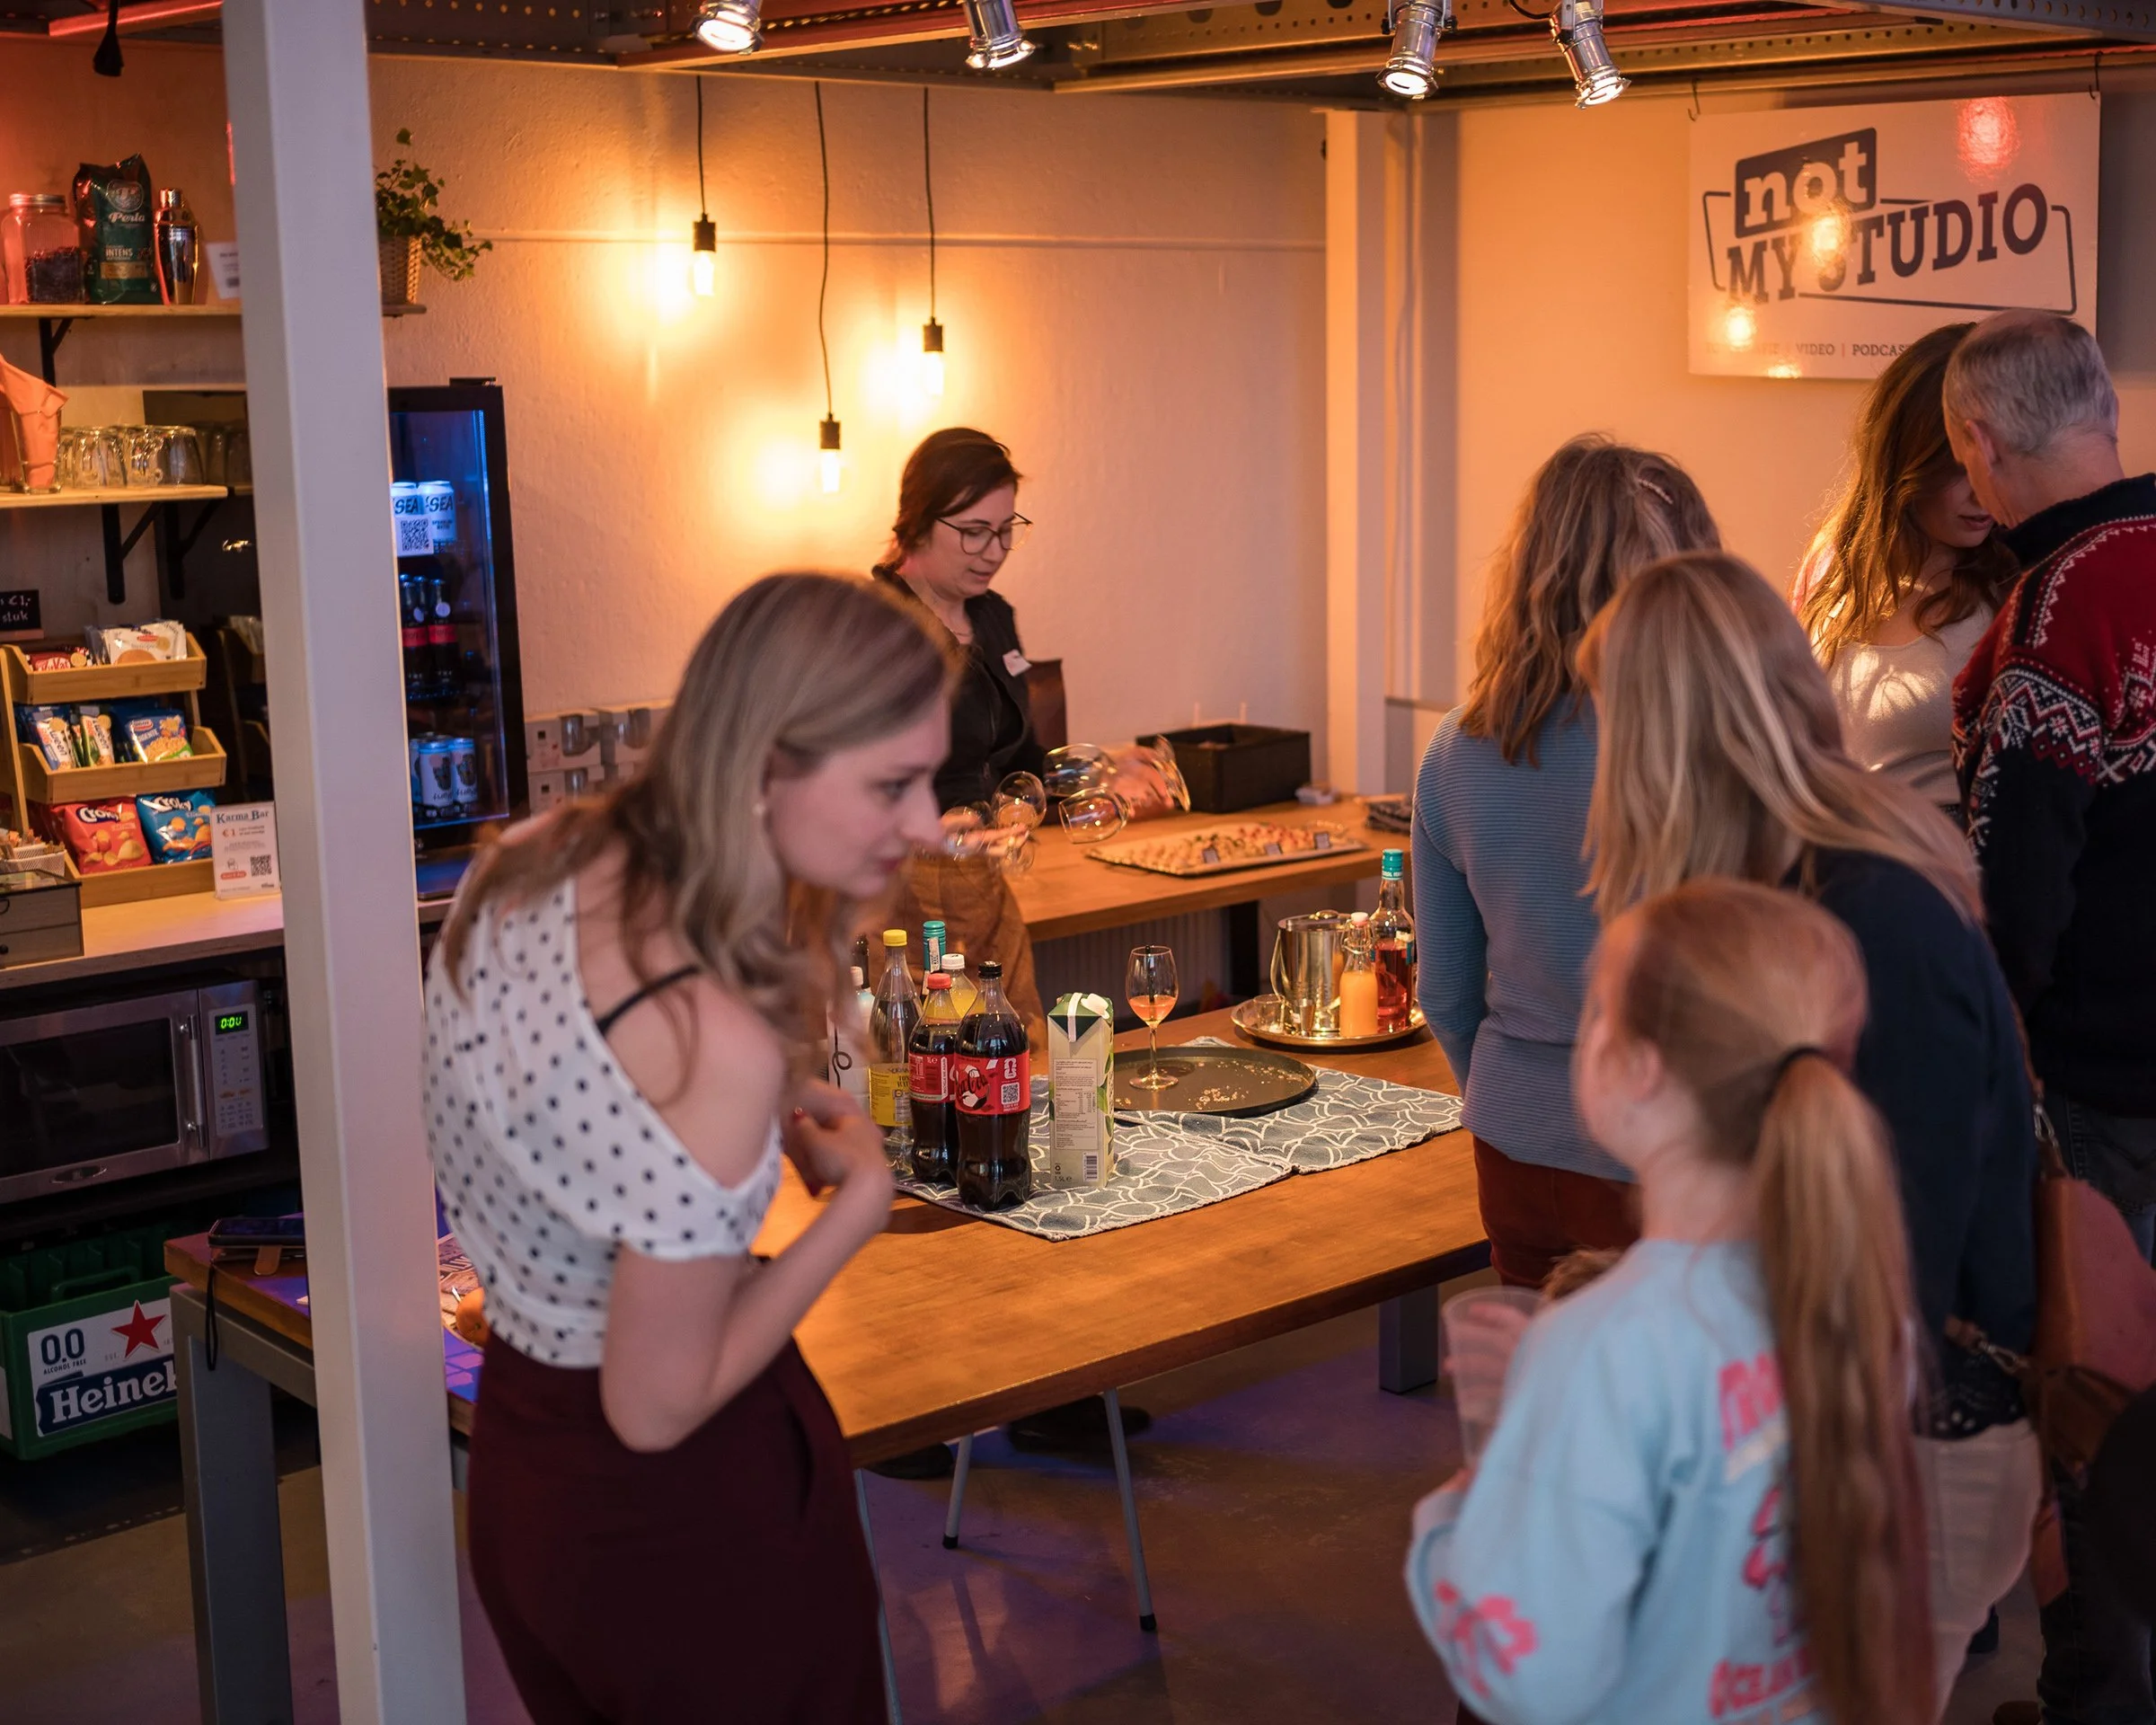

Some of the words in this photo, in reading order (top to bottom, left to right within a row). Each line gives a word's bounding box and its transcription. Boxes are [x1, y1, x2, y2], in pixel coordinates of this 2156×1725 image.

[1745, 141, 1868, 228] not
[109, 212, 146, 224] Perla
[1727, 232, 1802, 305] MY
[1816, 182, 2048, 293] STUDIO
[105, 247, 134, 257] INTENS
[1796, 342, 1835, 357] VIDEO
[154, 796, 192, 812] Croky
[216, 813, 249, 824] Karma
[252, 810, 270, 821] Bar
[40, 1328, 85, 1366] 0.0
[43, 1363, 71, 1376] ALCOHOL
[73, 1358, 87, 1368] FREE
